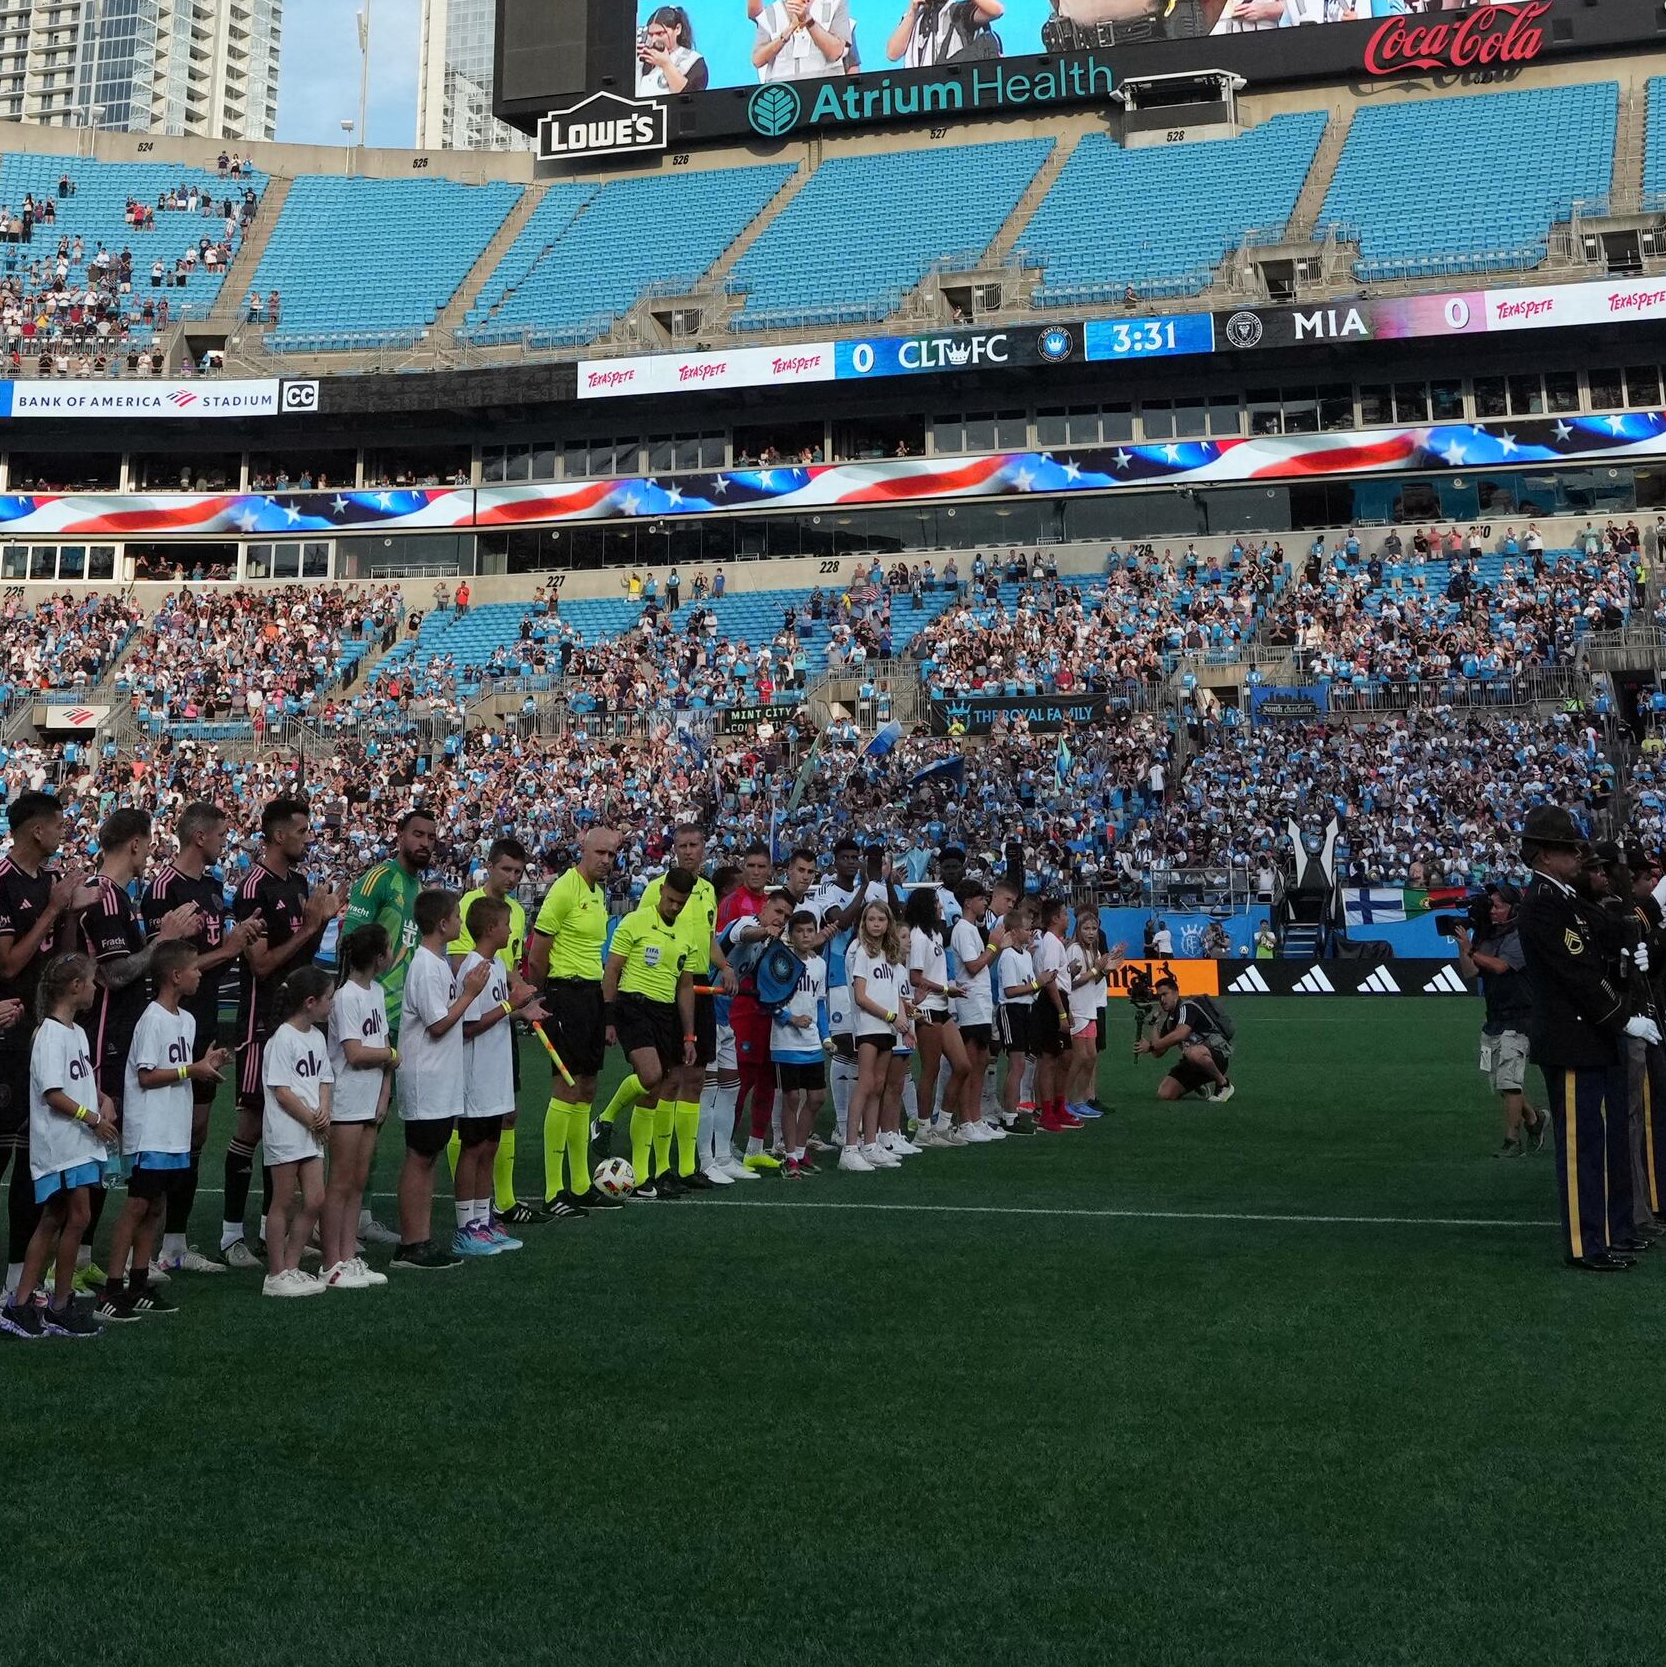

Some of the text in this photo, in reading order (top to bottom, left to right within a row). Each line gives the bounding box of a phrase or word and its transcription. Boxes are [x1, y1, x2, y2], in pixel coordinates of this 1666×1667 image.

[1363, 1, 1553, 75] Coca-Cola
[809, 56, 1113, 123] Atrium Health
[551, 113, 654, 152] LOWE'S
[930, 129, 947, 139] 527
[1166, 131, 1185, 142] 528
[138, 143, 154, 152] 524
[413, 158, 428, 169] 525
[672, 155, 689, 166] 526
[1293, 308, 1369, 339] MIA
[1445, 296, 1471, 329] 0
[1113, 320, 1176, 353] 3:31
[853, 343, 874, 373] 0
[898, 338, 952, 369] CLT
[971, 334, 1009, 364] FC
[19, 395, 272, 407] BANK OF AMERICA STADIUM
[820, 561, 840, 573] 228
[546, 576, 565, 587] 227
[731, 707, 792, 720] MINT CITY
[1001, 708, 1044, 723] ROYAL
[101, 937, 126, 950] Fracht
[645, 946, 660, 955] FIFA
